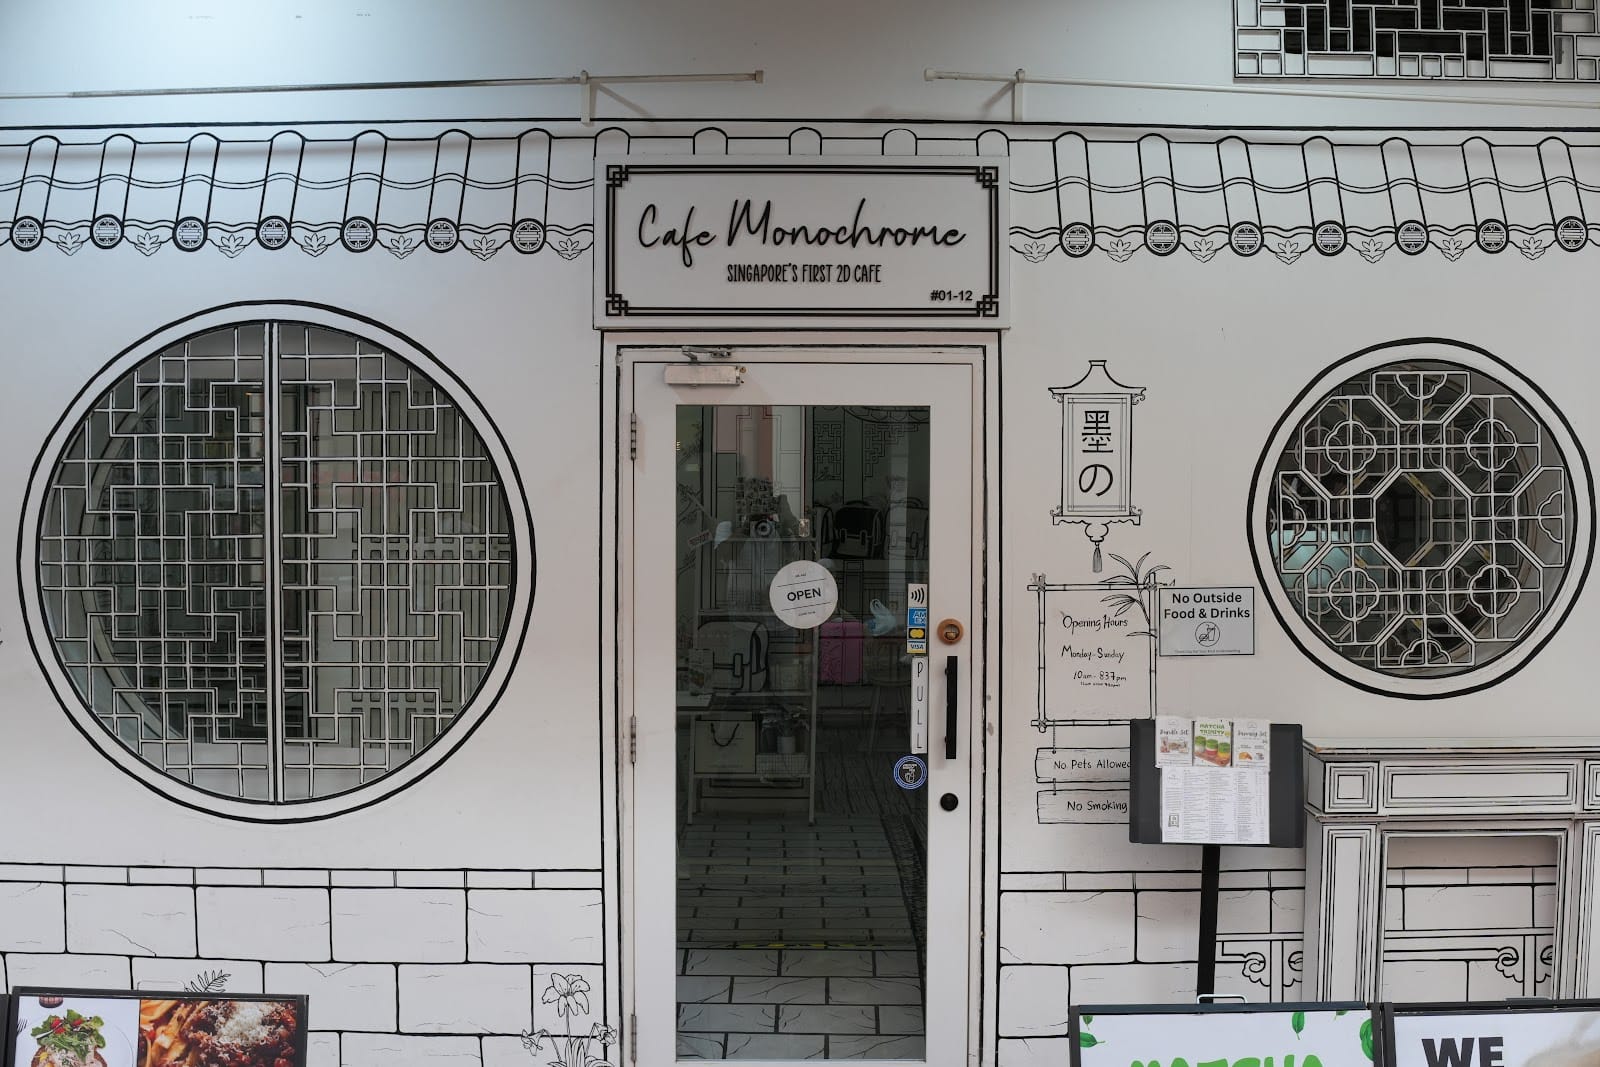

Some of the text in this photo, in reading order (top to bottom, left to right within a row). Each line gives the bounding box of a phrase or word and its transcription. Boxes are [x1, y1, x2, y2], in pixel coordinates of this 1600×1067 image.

[639, 198, 967, 268] Cafe Monochrome
[727, 262, 882, 283] SINGAPORE'S FIRST 2D CAFE
[930, 289, 973, 302] #01-12
[1079, 410, 1114, 497] 墨の
[786, 587, 822, 602] OPEN
[1172, 592, 1242, 604] No Outside
[1164, 607, 1251, 619] Food & Drinks
[1062, 613, 1128, 636] Opening Hours
[1097, 647, 1125, 664] Sunday
[916, 661, 924, 749] PULL
[1053, 760, 1067, 770] No
[1071, 757, 1092, 770] Pets
[1067, 799, 1128, 814] No Smoking
[1421, 1036, 1505, 1067] WE
